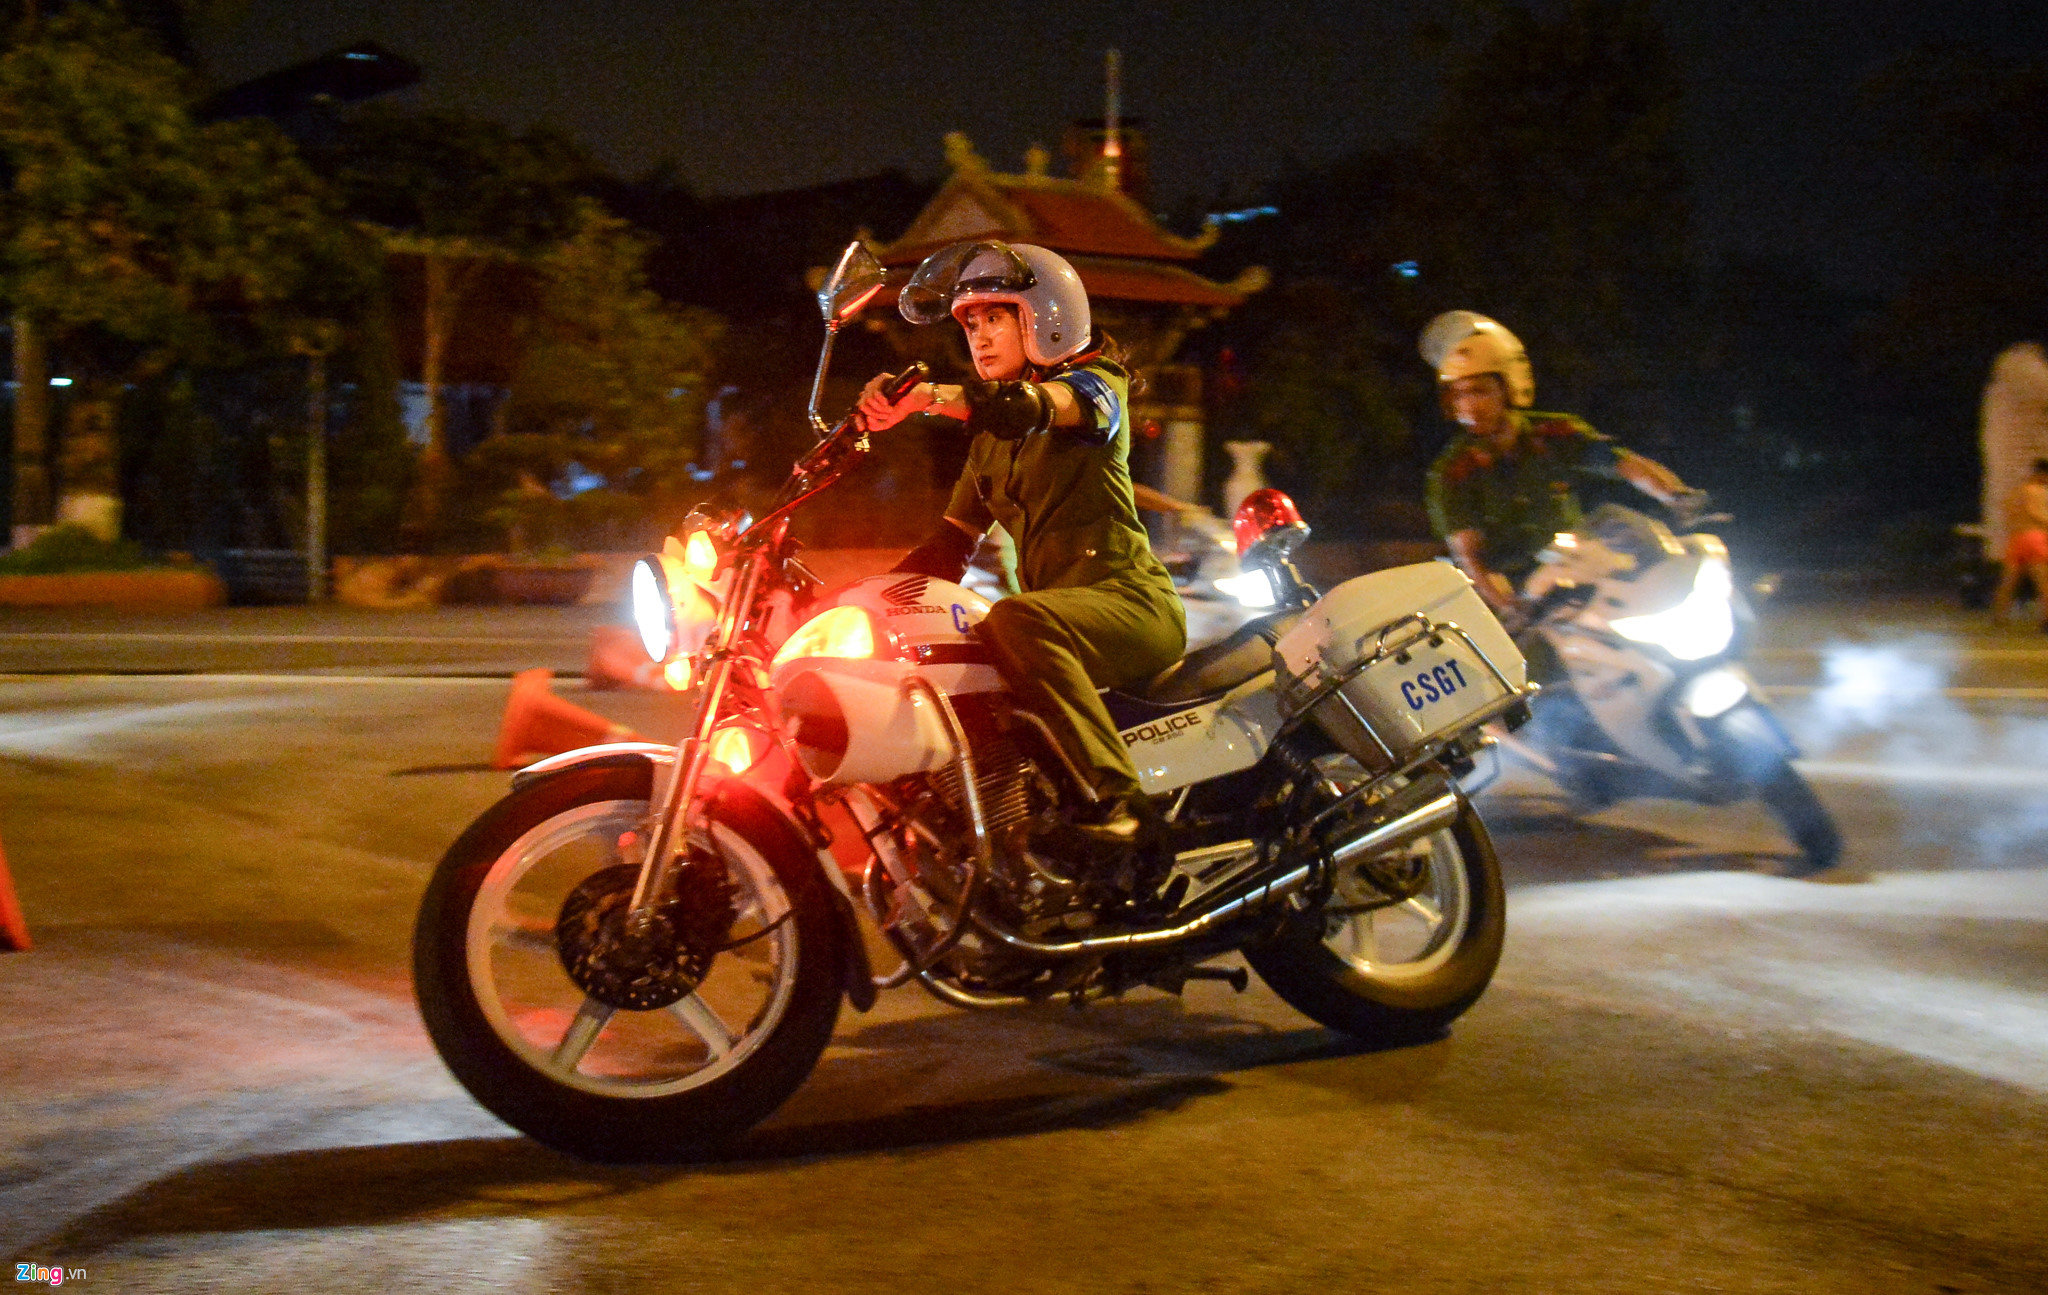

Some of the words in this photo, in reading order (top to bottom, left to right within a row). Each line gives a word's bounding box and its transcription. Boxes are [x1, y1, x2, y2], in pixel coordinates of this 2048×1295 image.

[886, 605, 947, 617] HONDA
[1400, 659, 1467, 711] CSGT
[1122, 711, 1202, 748] POLICE
